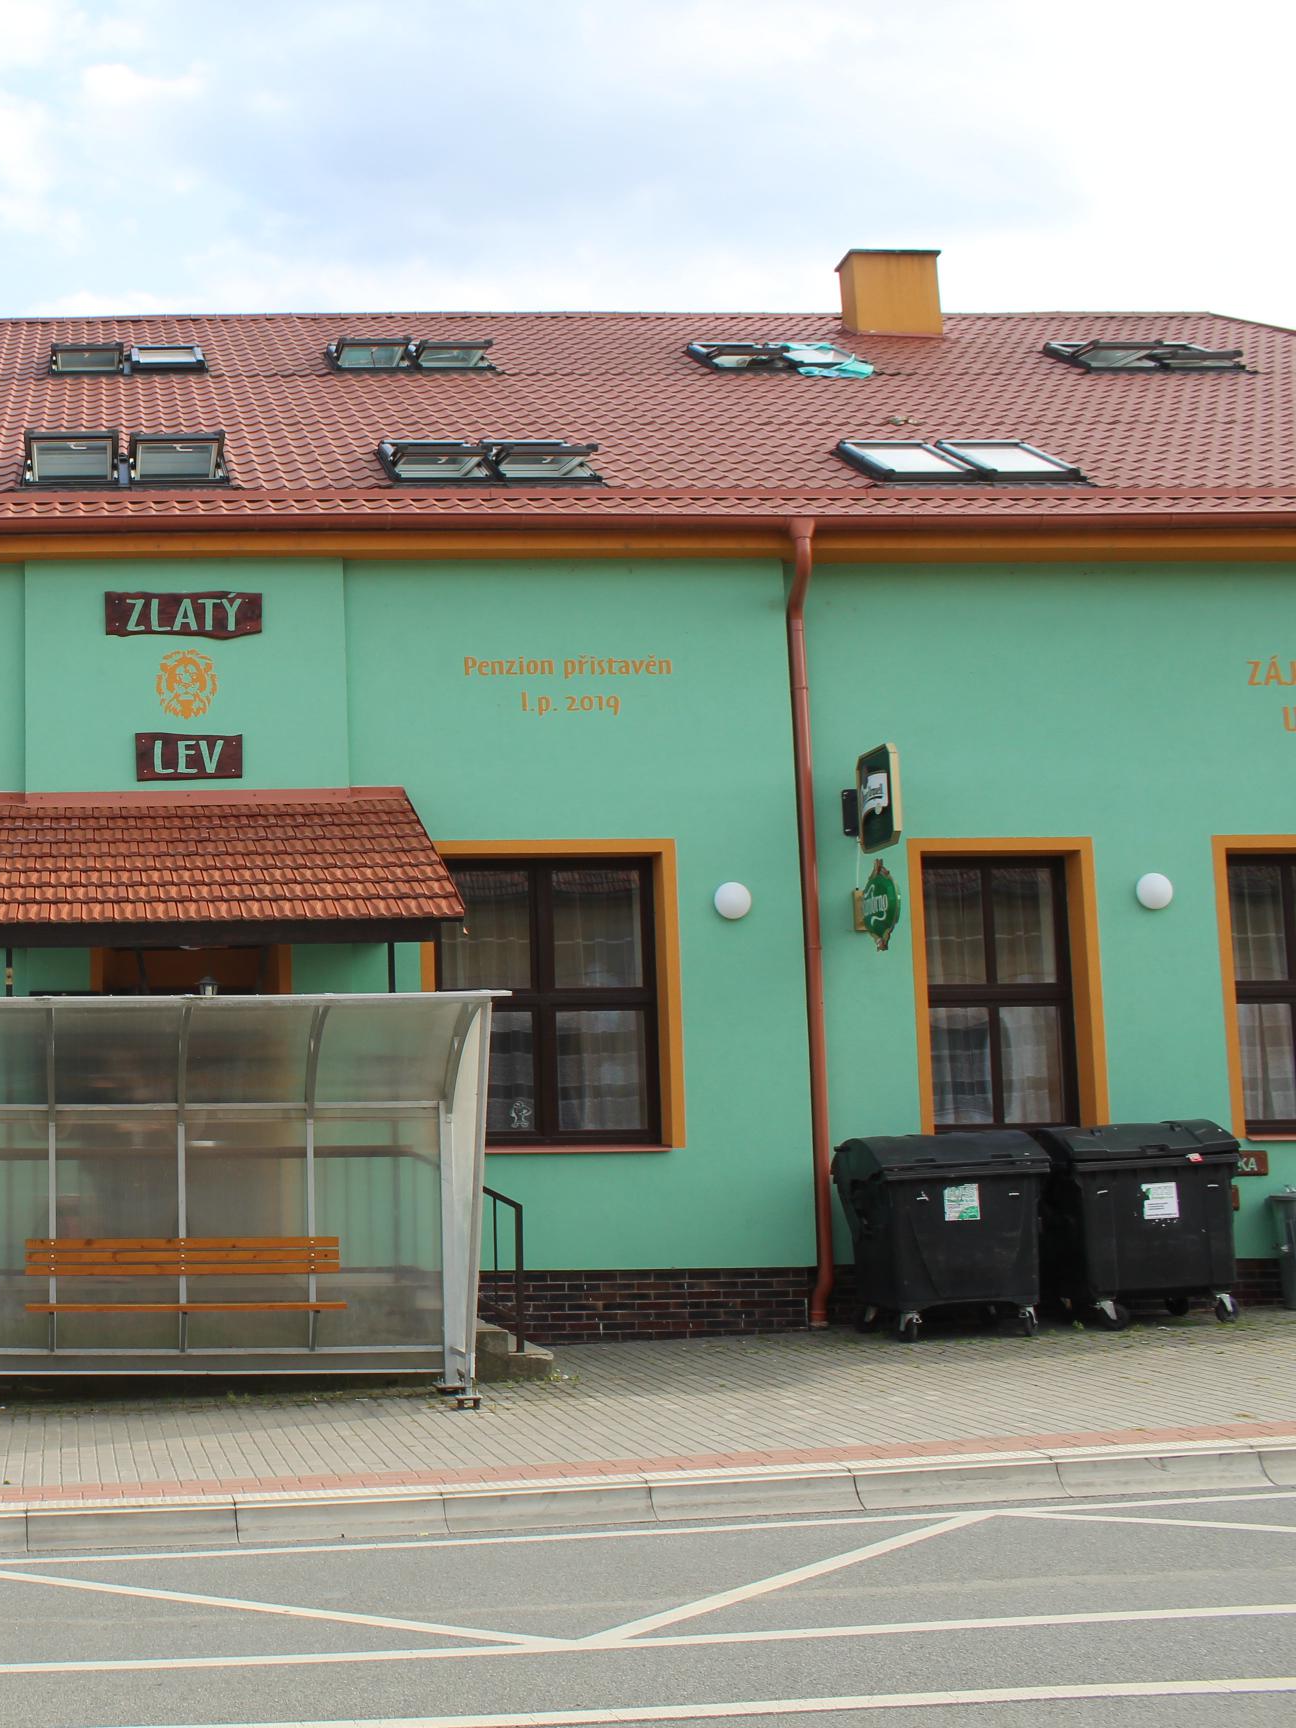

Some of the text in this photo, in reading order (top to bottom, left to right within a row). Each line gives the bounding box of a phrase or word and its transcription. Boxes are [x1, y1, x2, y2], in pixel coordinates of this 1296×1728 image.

[126, 592, 243, 632] ZLATÝ
[463, 655, 554, 676] Penzion
[566, 695, 622, 716] 2019
[154, 740, 224, 774] LEV
